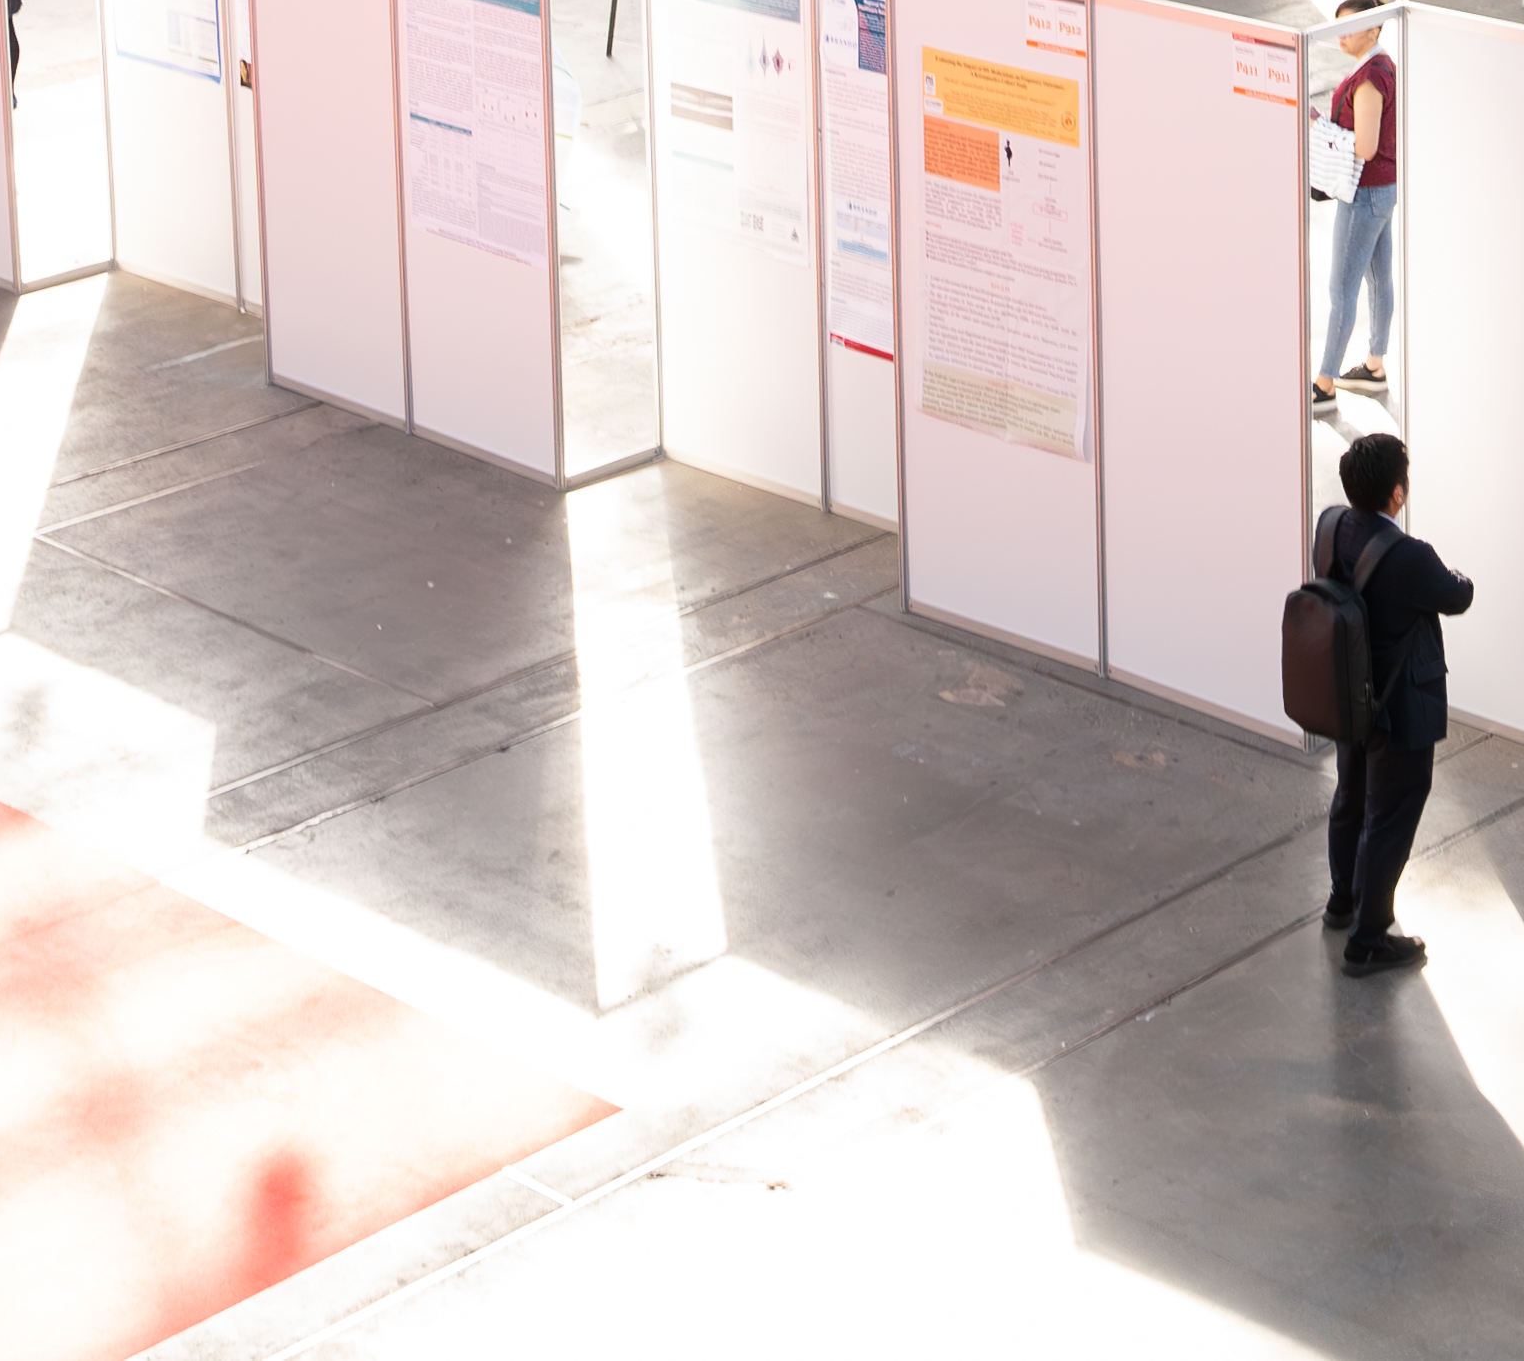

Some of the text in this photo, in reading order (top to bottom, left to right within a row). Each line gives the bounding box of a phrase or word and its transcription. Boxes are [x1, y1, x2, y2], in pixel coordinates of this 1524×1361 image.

[1028, 14, 1052, 30] P412
[1059, 20, 1082, 36] P912
[1236, 60, 1258, 77] P411
[1268, 67, 1291, 84] P911
